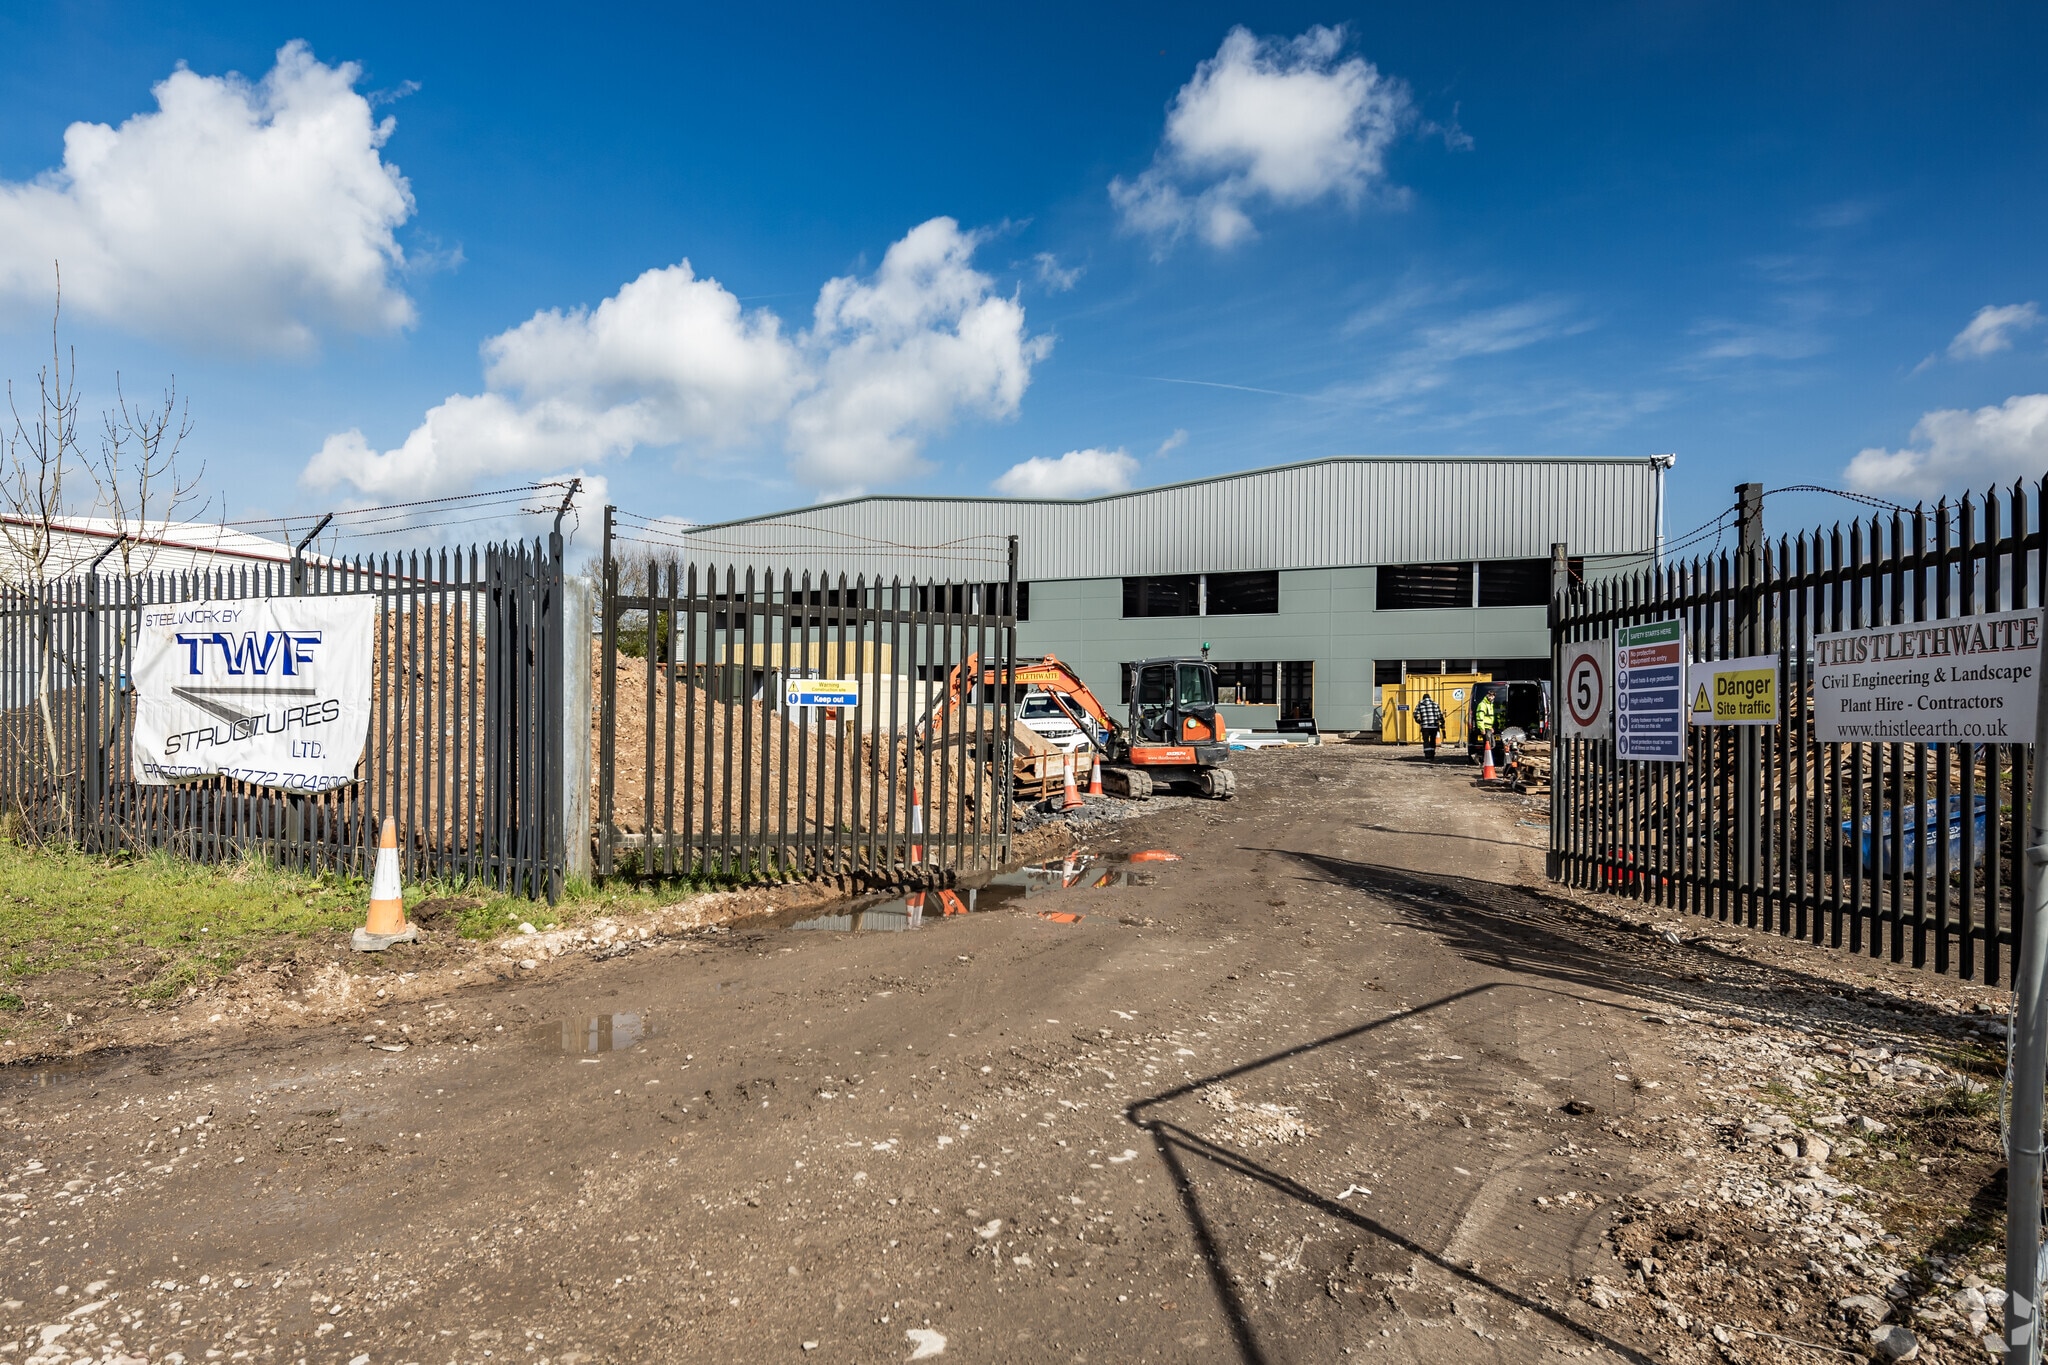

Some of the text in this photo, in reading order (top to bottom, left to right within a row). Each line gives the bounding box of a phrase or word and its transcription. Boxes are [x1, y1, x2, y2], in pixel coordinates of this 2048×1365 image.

[222, 610, 242, 622] BY
[1630, 628, 1672, 640] SAFETY STARTS HERE
[1816, 617, 2040, 667] THISTLETHWAITE
[175, 630, 322, 675] TWF
[1637, 649, 1656, 657] protective
[1822, 664, 2032, 690] Civil Engineering & Landscape
[1577, 670, 1591, 710] 5
[1717, 675, 1771, 699] Danger
[814, 695, 831, 703] Keep
[1717, 700, 1771, 715] Site traffic
[1840, 698, 1871, 712] Plant
[1875, 696, 1903, 712] Hire
[1917, 695, 2003, 711] Contractors
[164, 699, 339, 755] STRUCTURES
[1837, 718, 2008, 737] www.thistleearth.co.uk
[292, 738, 326, 758] LTD.
